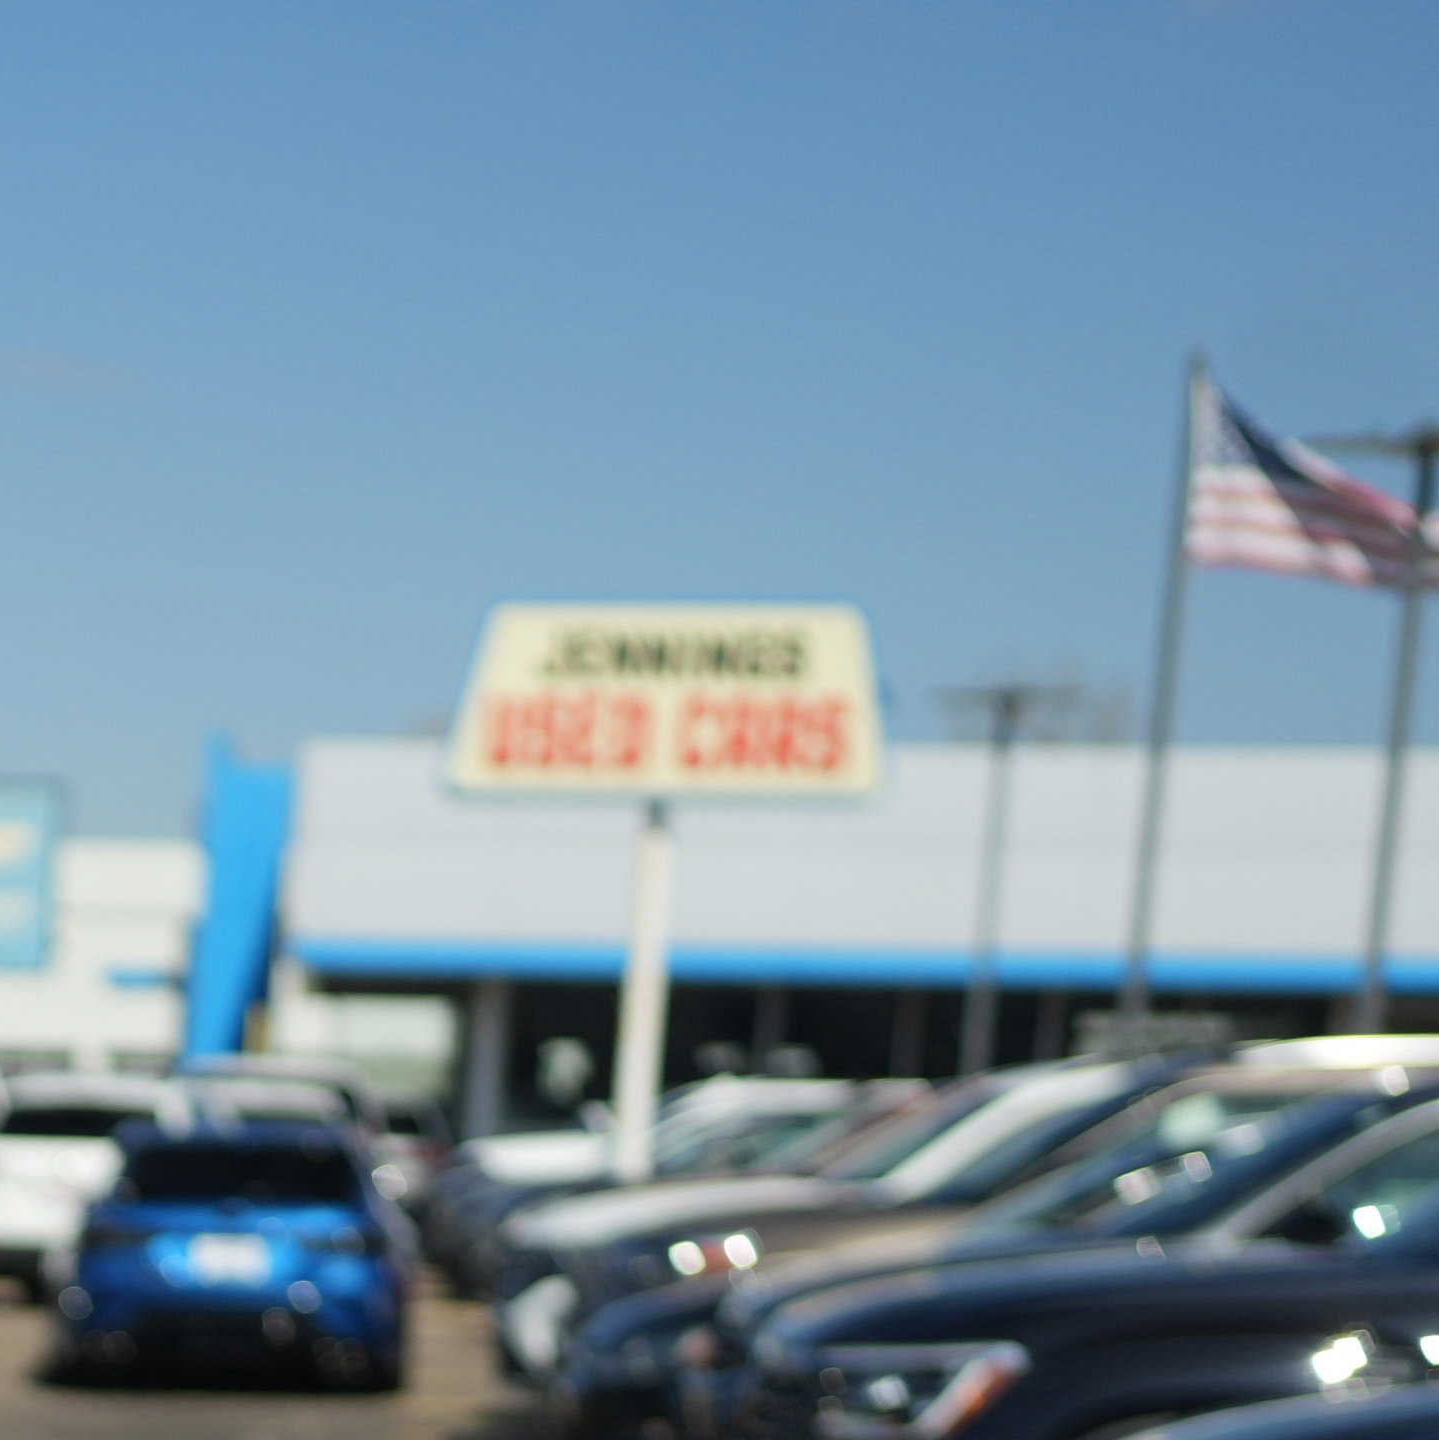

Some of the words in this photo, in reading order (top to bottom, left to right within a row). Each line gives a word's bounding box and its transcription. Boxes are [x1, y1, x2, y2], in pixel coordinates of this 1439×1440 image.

[542, 630, 807, 677] JENNINGS
[486, 692, 648, 770] USED
[676, 692, 851, 770] CARS
